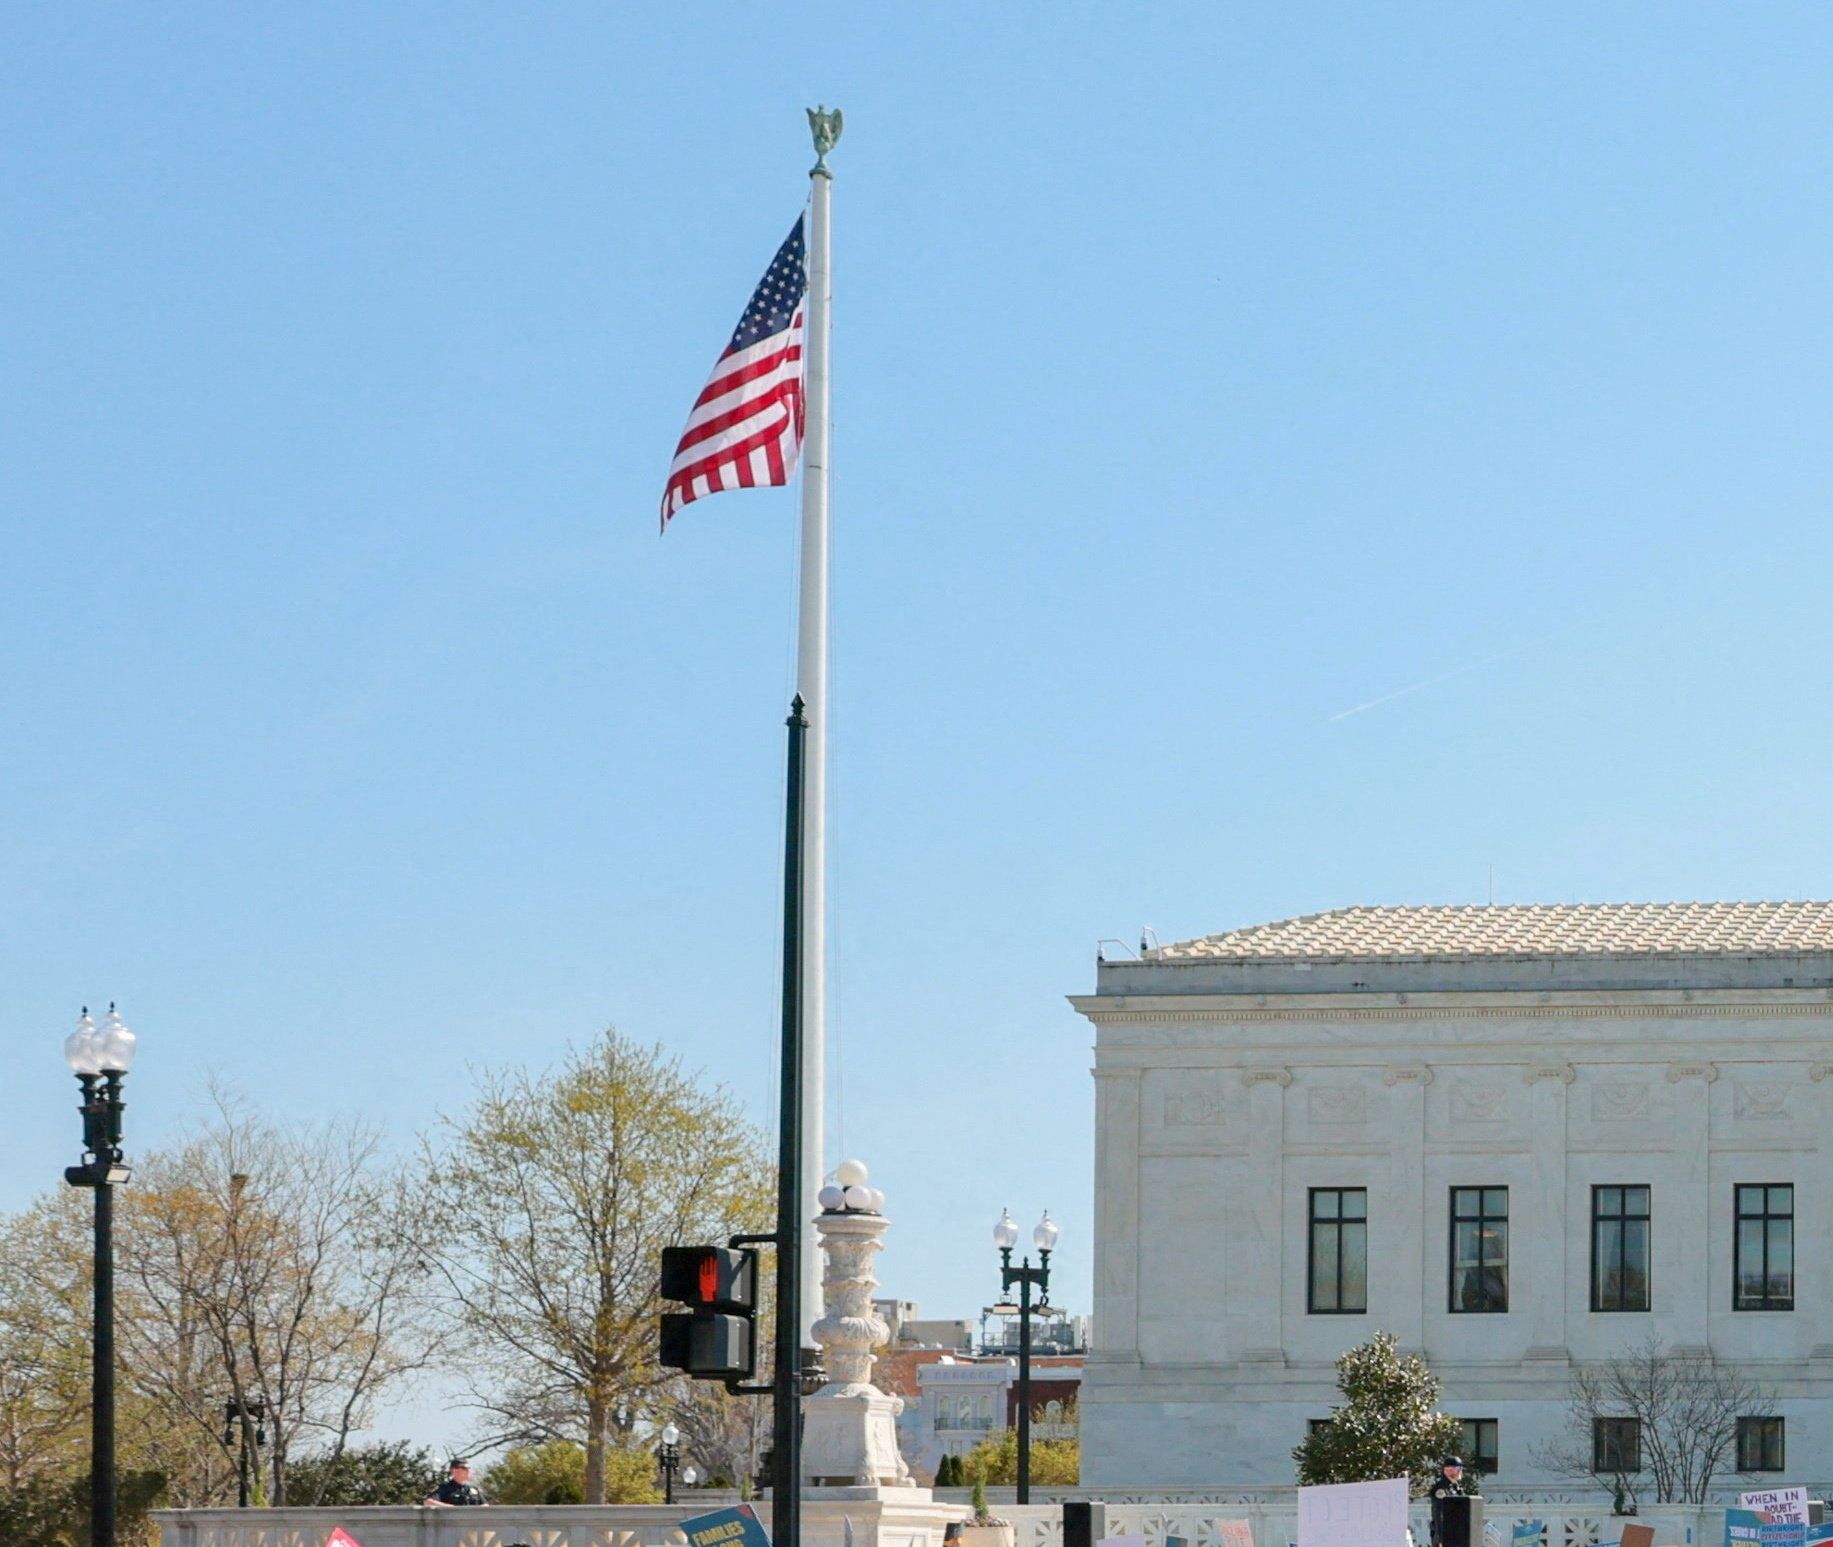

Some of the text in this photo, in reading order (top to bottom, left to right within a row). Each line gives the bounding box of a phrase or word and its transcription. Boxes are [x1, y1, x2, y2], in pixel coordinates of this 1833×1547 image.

[1745, 1490, 1799, 1506] WHEN IN
[691, 1520, 746, 1547] FAMILIES
